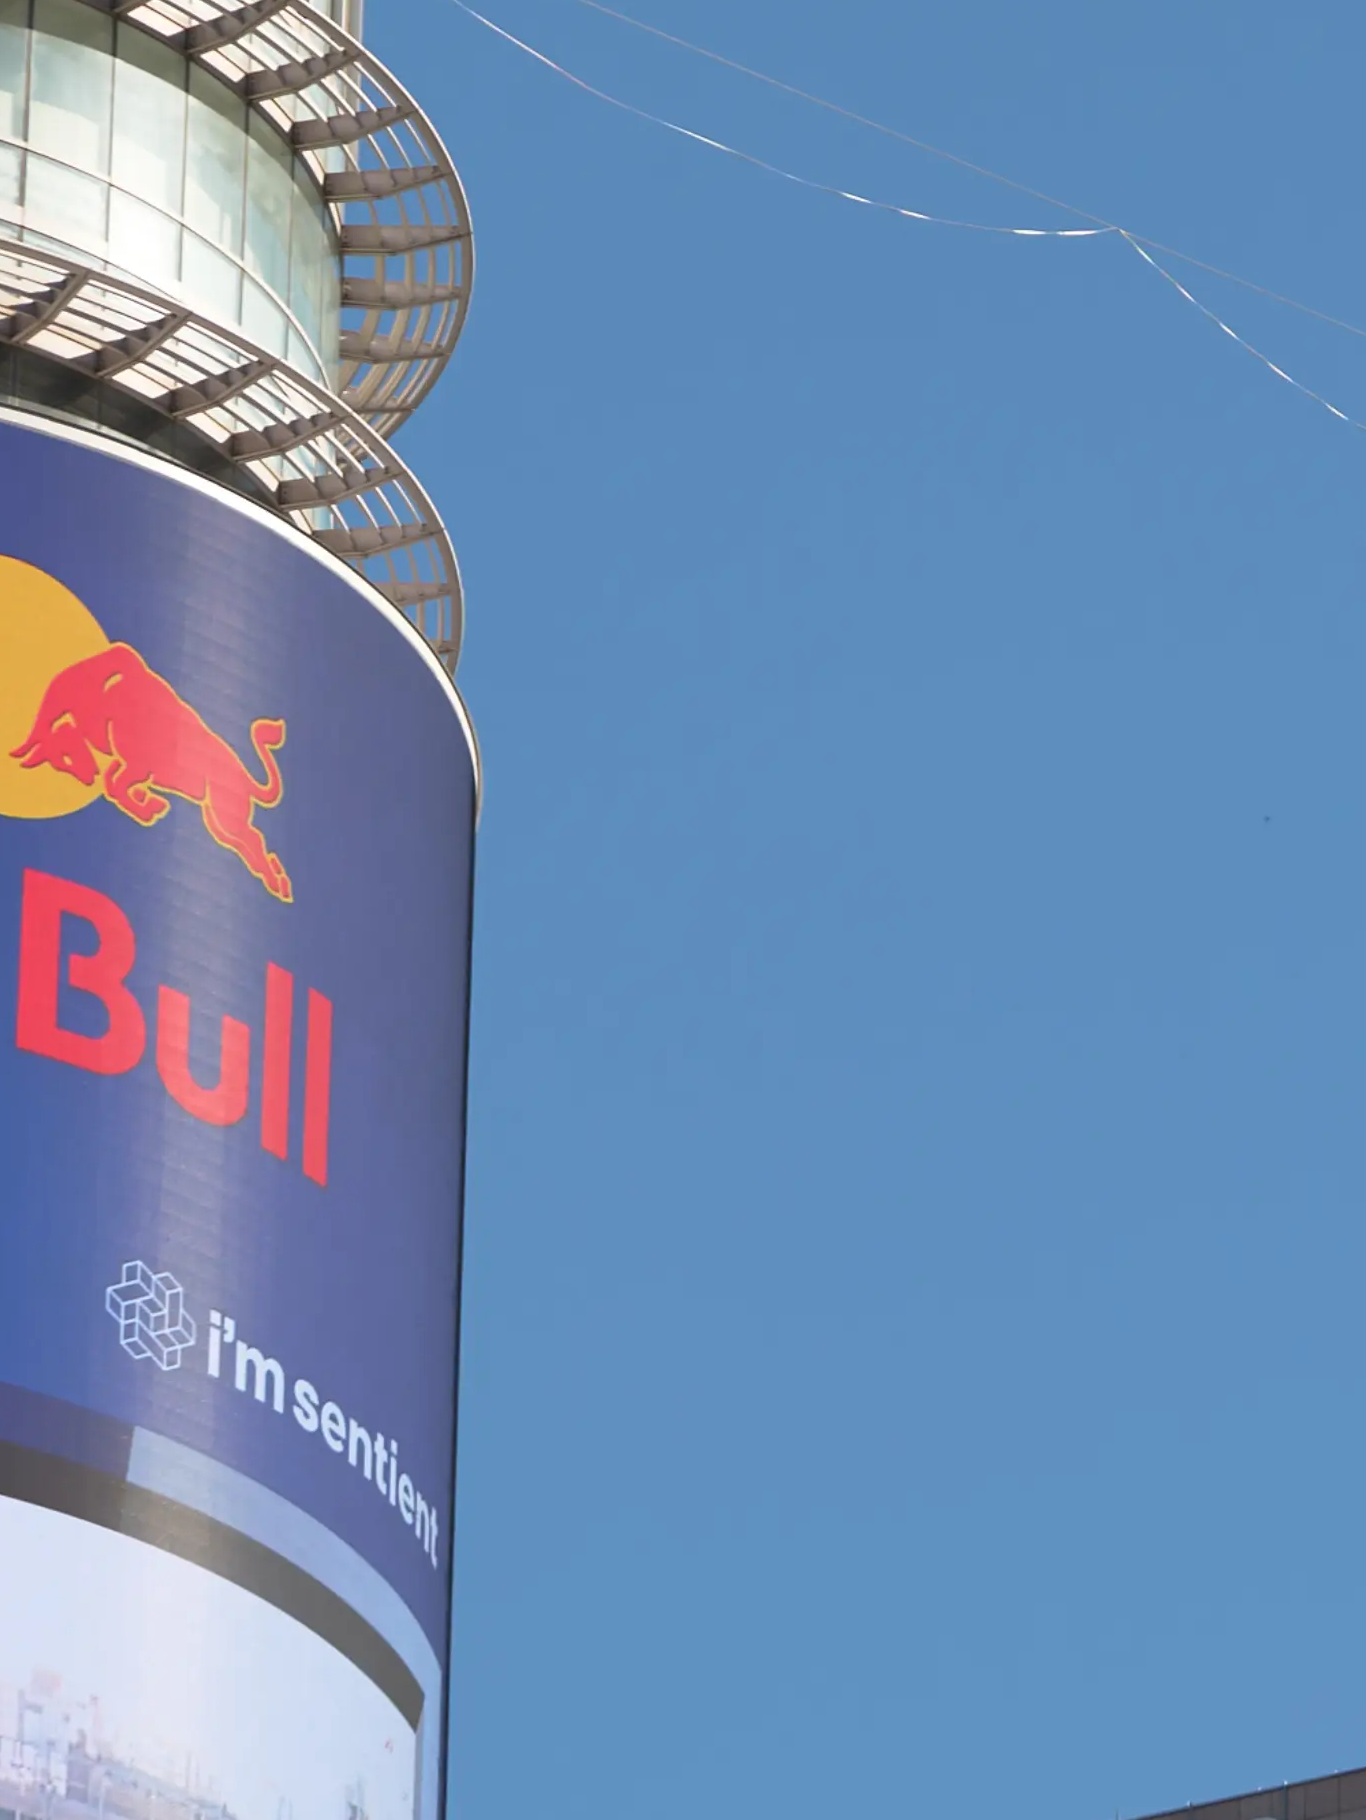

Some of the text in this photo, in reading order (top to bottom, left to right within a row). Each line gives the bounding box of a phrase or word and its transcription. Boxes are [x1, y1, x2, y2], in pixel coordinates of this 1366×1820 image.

[15, 866, 334, 1188] Bull
[206, 1308, 440, 1570] i'm sentient
